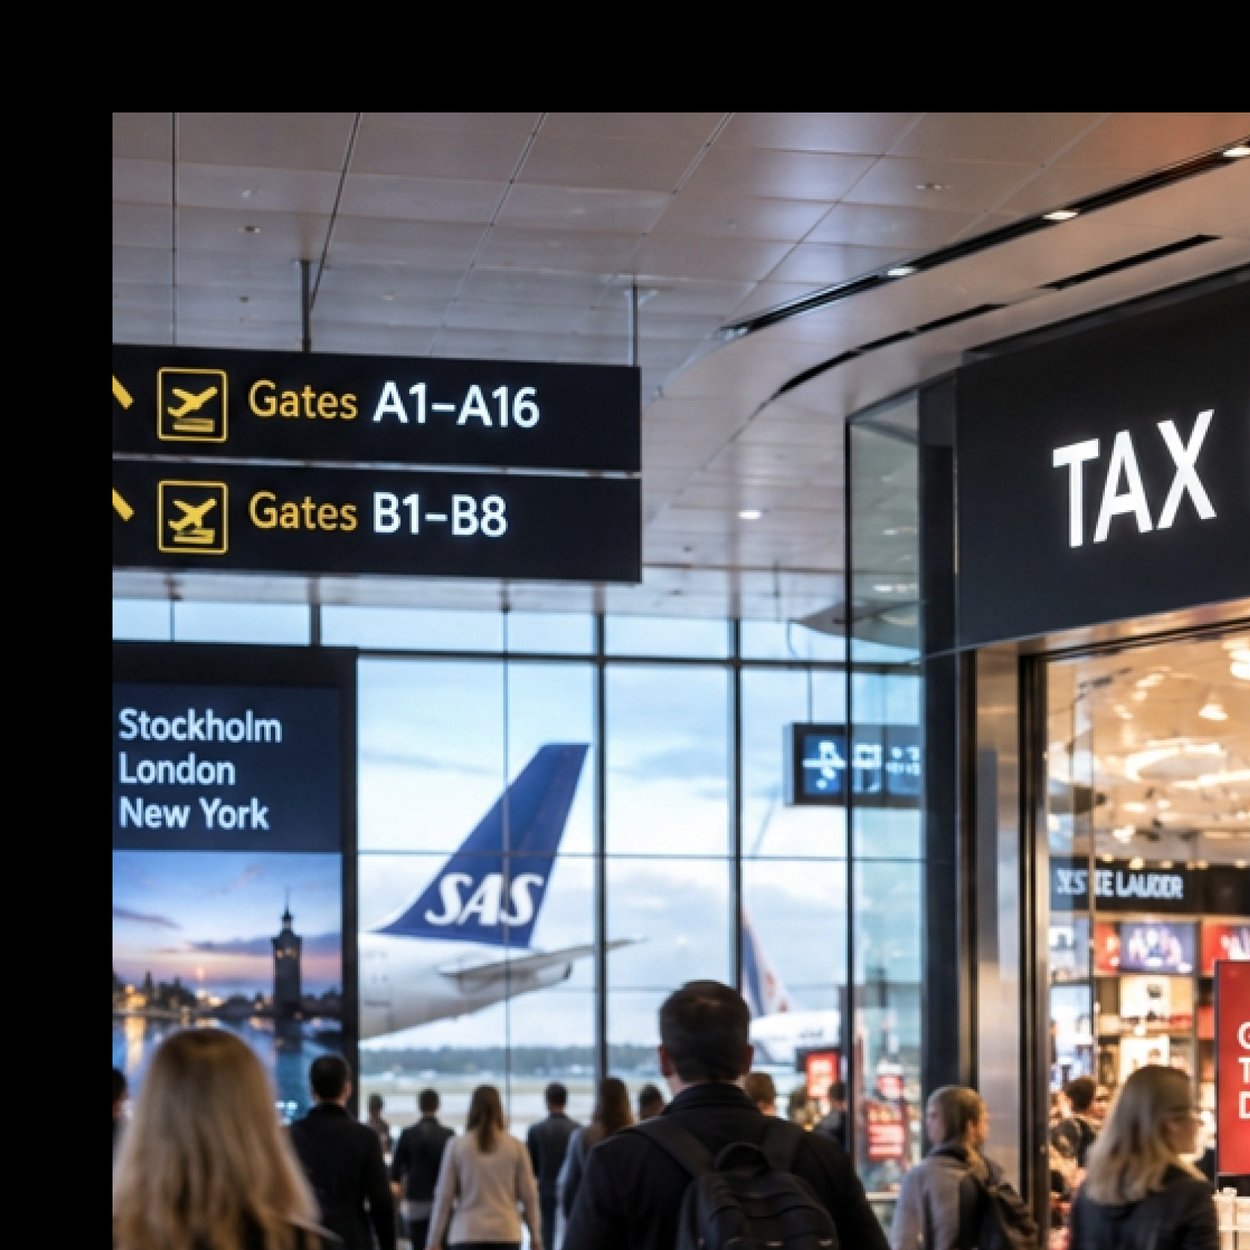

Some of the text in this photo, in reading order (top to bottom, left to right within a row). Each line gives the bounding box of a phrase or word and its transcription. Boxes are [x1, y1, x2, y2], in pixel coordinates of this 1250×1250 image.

[248, 379, 358, 420] Gates
[1052, 408, 1217, 549] TAX
[248, 491, 358, 531] Gates
[118, 708, 282, 744] Stockholm
[118, 752, 236, 786] London
[118, 797, 269, 831] New York
[424, 873, 544, 927] SAS
